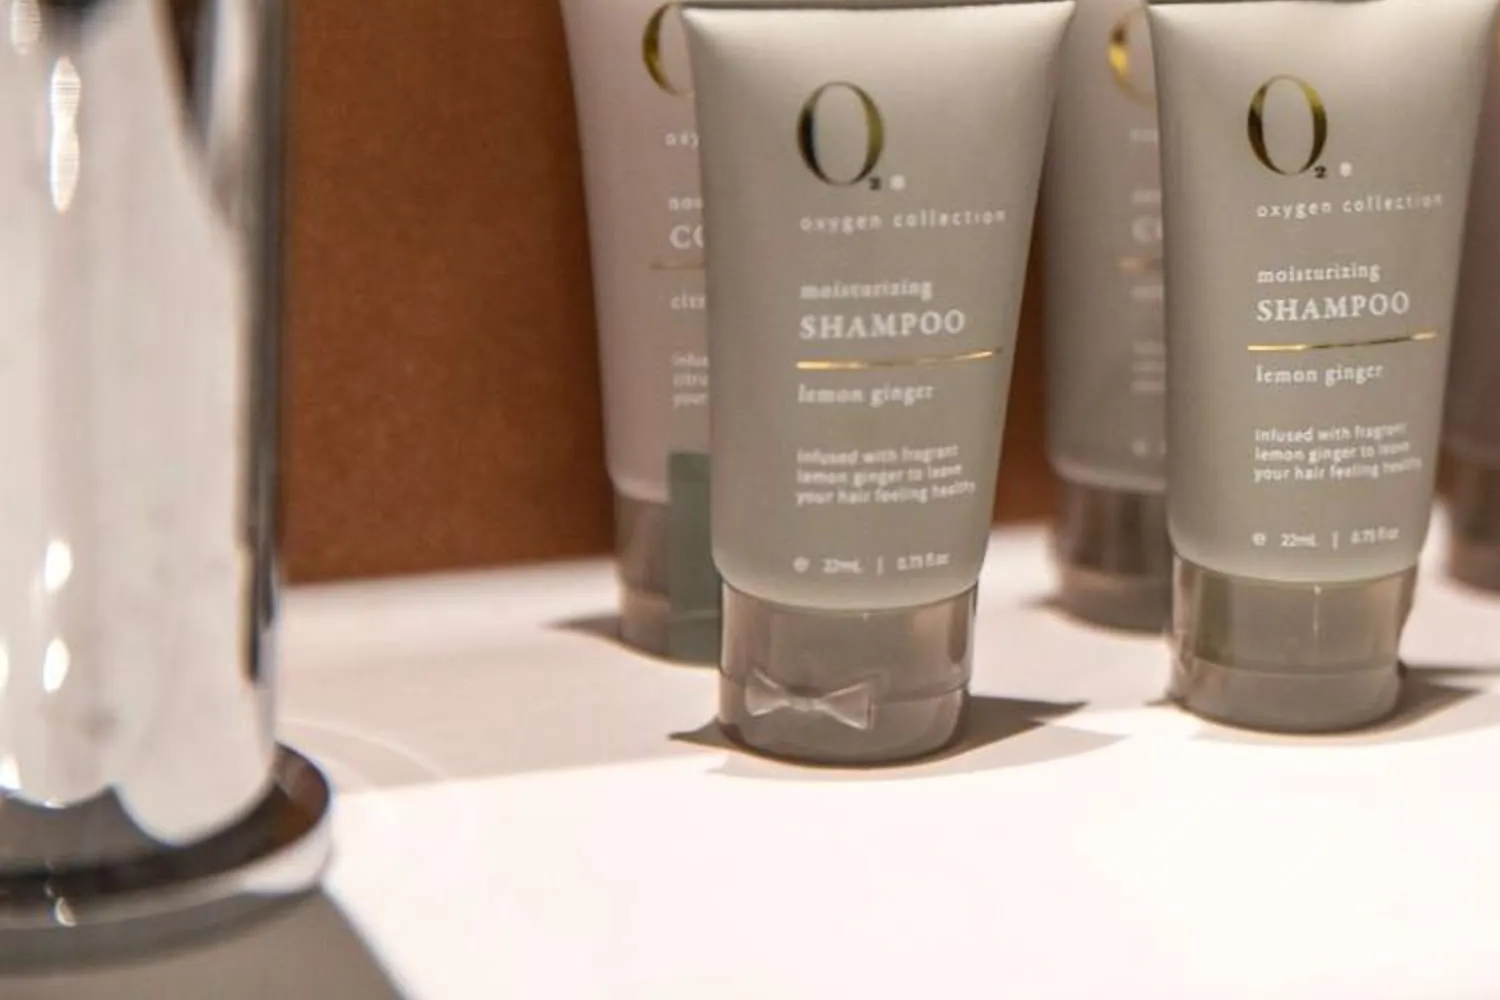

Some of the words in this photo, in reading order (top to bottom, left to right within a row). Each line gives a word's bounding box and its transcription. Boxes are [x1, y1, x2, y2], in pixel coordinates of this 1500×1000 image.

[1256, 201, 1332, 219] oxygen
[1342, 193, 1444, 213] collection
[800, 214, 882, 236] oxygen
[893, 208, 1006, 229] collection
[1256, 262, 1381, 283] moisturizing
[800, 279, 933, 302] moisturizing
[1256, 292, 1410, 321] SHAMPOO
[800, 309, 966, 340] SHAMPOO
[1256, 364, 1318, 383] lemon
[1325, 364, 1384, 387] ginger
[798, 383, 863, 404] lemon
[869, 384, 935, 407] ginger
[1317, 425, 1351, 441] with
[860, 449, 898, 464] with
[1254, 445, 1305, 462] lemon
[1308, 447, 1357, 464] ginger
[1359, 445, 1375, 458] to
[796, 467, 848, 484] lemon
[853, 470, 903, 488] ginger
[1252, 468, 1291, 484] your
[1294, 464, 1325, 480] hair
[1330, 464, 1379, 480] feeling
[795, 491, 835, 507] your
[837, 487, 872, 504] hair
[874, 486, 929, 504] feeling
